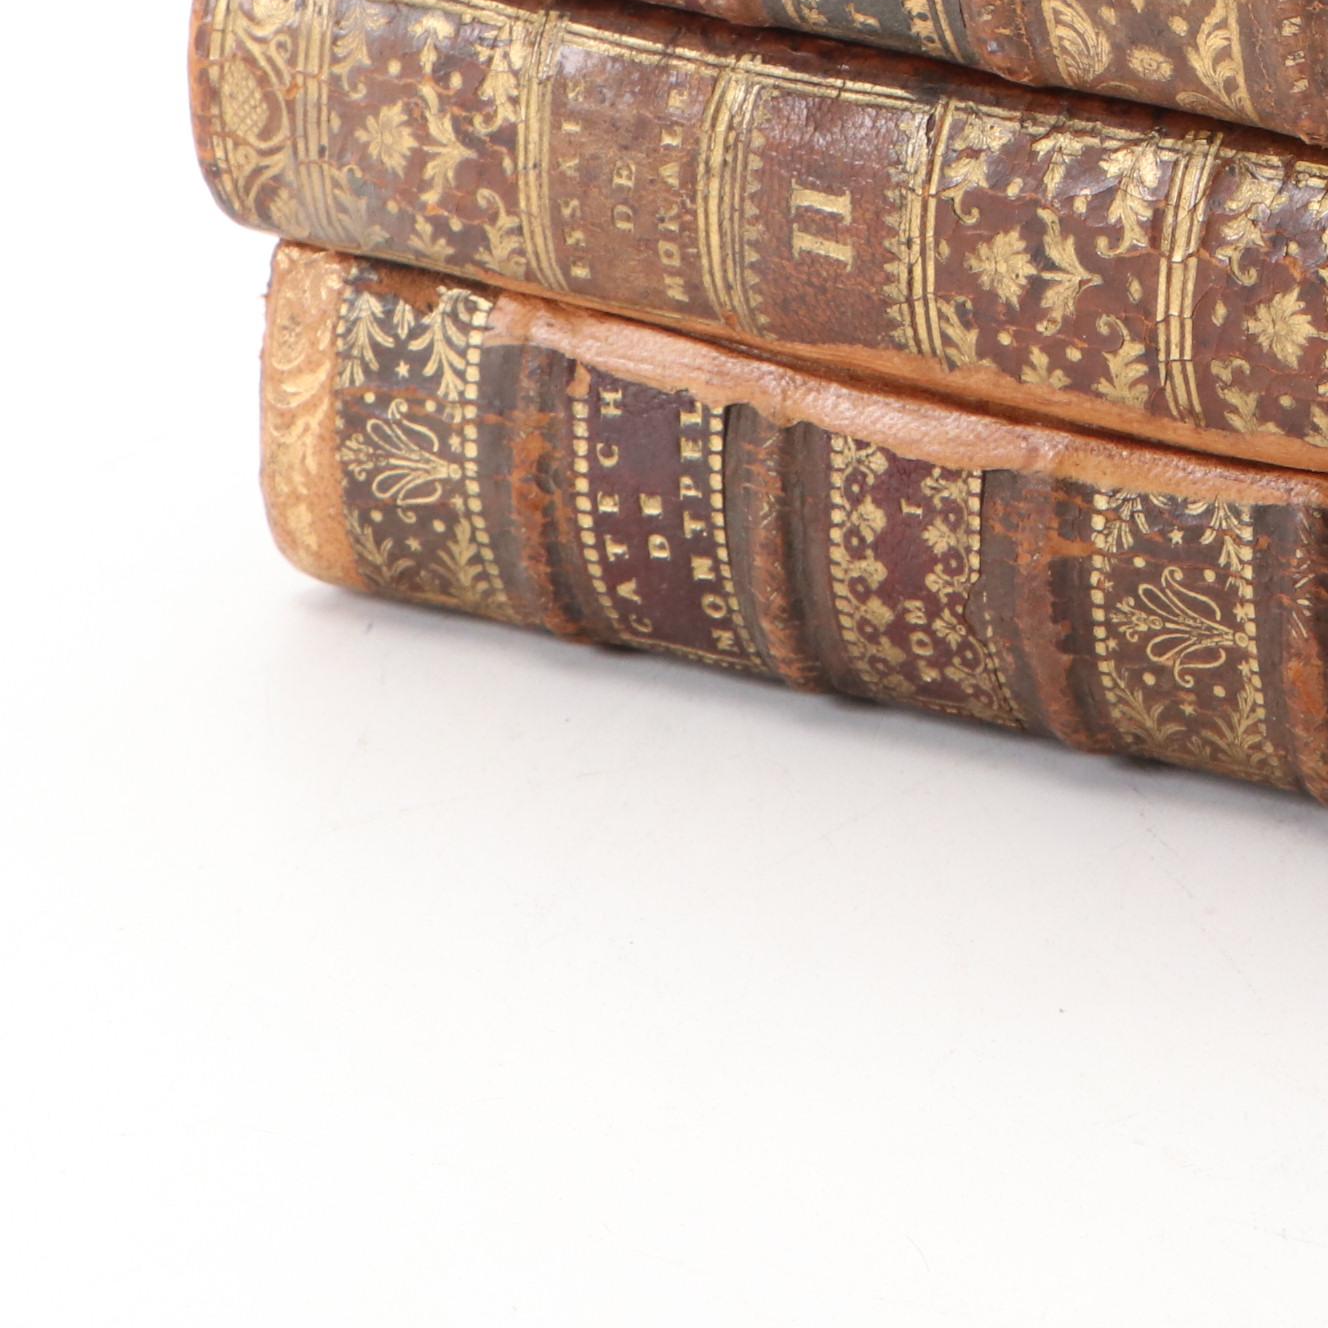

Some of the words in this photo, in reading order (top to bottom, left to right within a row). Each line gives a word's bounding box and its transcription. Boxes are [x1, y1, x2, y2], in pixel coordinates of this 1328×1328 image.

[558, 78, 592, 280] ESSAIS
[611, 159, 636, 234] DE
[657, 87, 690, 302] MORALE
[788, 177, 854, 273] II
[597, 387, 653, 633] CATECH
[639, 493, 671, 561] DE
[679, 401, 740, 653] MONTPEL
[900, 498, 924, 520] I
[903, 599, 941, 683] TOM
